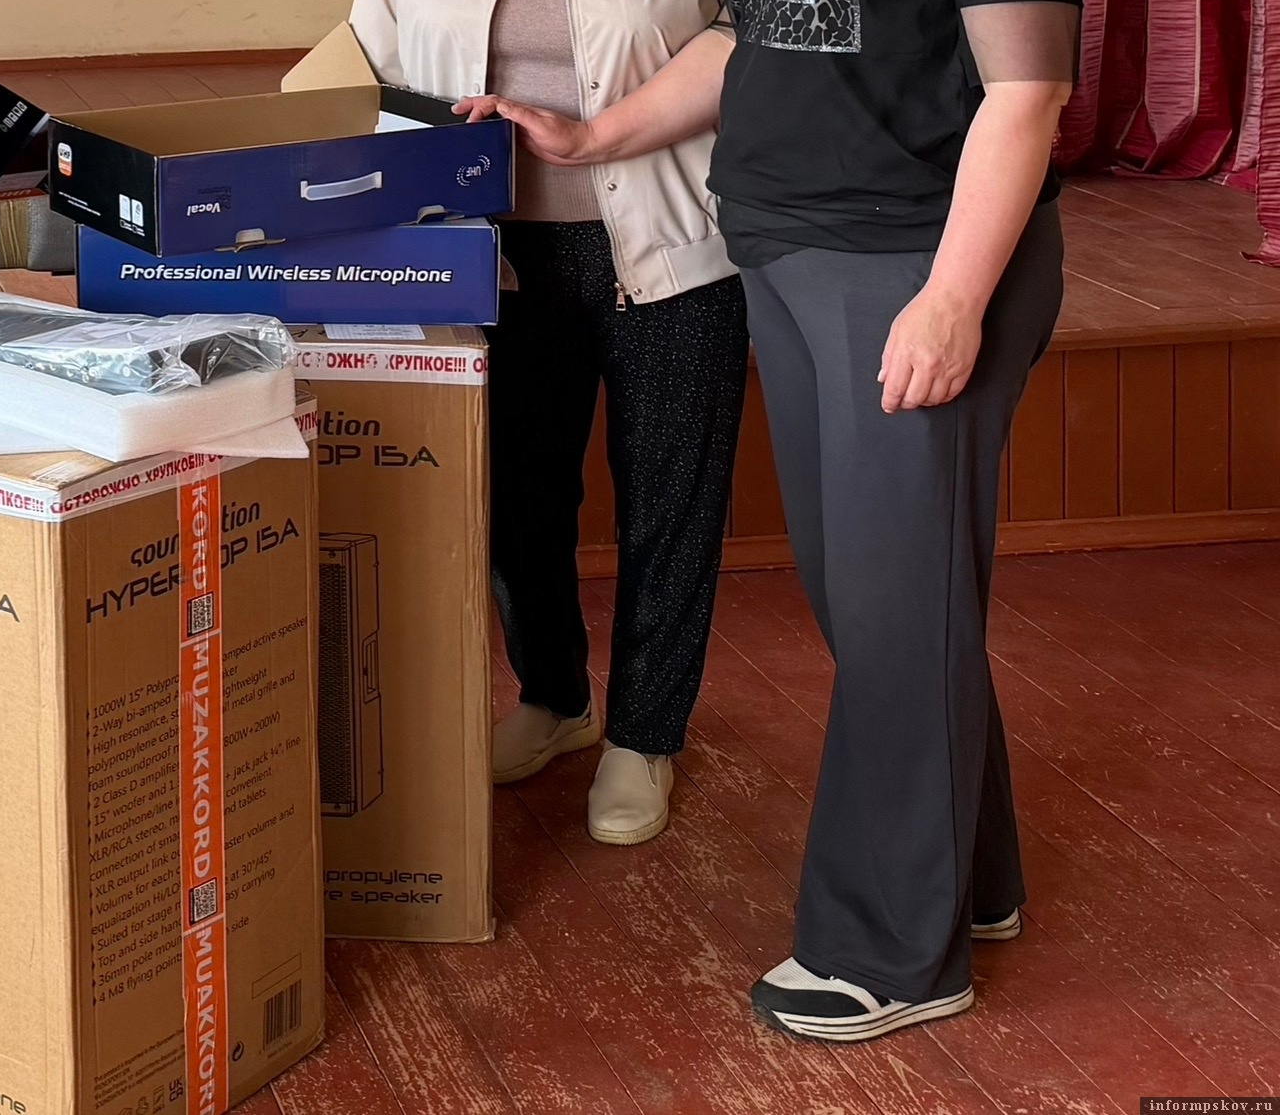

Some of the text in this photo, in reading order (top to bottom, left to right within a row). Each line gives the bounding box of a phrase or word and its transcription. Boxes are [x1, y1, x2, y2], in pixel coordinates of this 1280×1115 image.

[187, 202, 221, 216] Vocal
[120, 264, 453, 284] Professional Wireless Microphone
[93, 694, 126, 720] 1000W
[222, 639, 251, 662] amped
[253, 631, 277, 649] active
[278, 616, 307, 638] speaker
[88, 737, 157, 778] polypropylene
[232, 688, 256, 709] metal
[280, 669, 295, 686] and
[93, 717, 124, 737] 2-Way
[126, 692, 171, 722] bi-amped
[93, 736, 116, 755] High
[119, 715, 169, 744] resonance,
[88, 775, 114, 793] foam
[116, 745, 171, 780] soundproof
[192, 638, 212, 879] MUZAKKORD
[93, 796, 100, 809] 2
[102, 786, 127, 804] Class
[129, 779, 138, 792] D
[94, 799, 174, 844] Microphone/line
[233, 760, 251, 780] jack
[251, 750, 269, 772] jack
[285, 736, 301, 750] line
[112, 794, 146, 817] woofer
[148, 783, 167, 800] and
[89, 835, 133, 865] XLR/RCA
[225, 766, 272, 798] convenient
[89, 850, 144, 882] connection
[146, 840, 156, 855] of
[239, 788, 267, 809] tablets
[95, 890, 133, 914] Volume
[135, 882, 149, 895] for
[152, 869, 174, 887] each
[247, 816, 277, 838] volume
[279, 804, 294, 821] and
[95, 880, 115, 898] XLR
[117, 864, 149, 887] output
[151, 853, 169, 869] link
[323, 869, 443, 885] propylene
[91, 899, 151, 935] equalization
[97, 926, 128, 951] Suited
[131, 921, 145, 933] for
[147, 905, 172, 926] stage
[230, 870, 239, 882] at
[351, 890, 443, 904] speaker
[98, 953, 116, 968] Top
[118, 939, 137, 957] and
[139, 930, 159, 947] side
[99, 964, 129, 986] 36mm
[132, 951, 153, 972] pole
[232, 916, 249, 933] side
[99, 992, 106, 1003] 4
